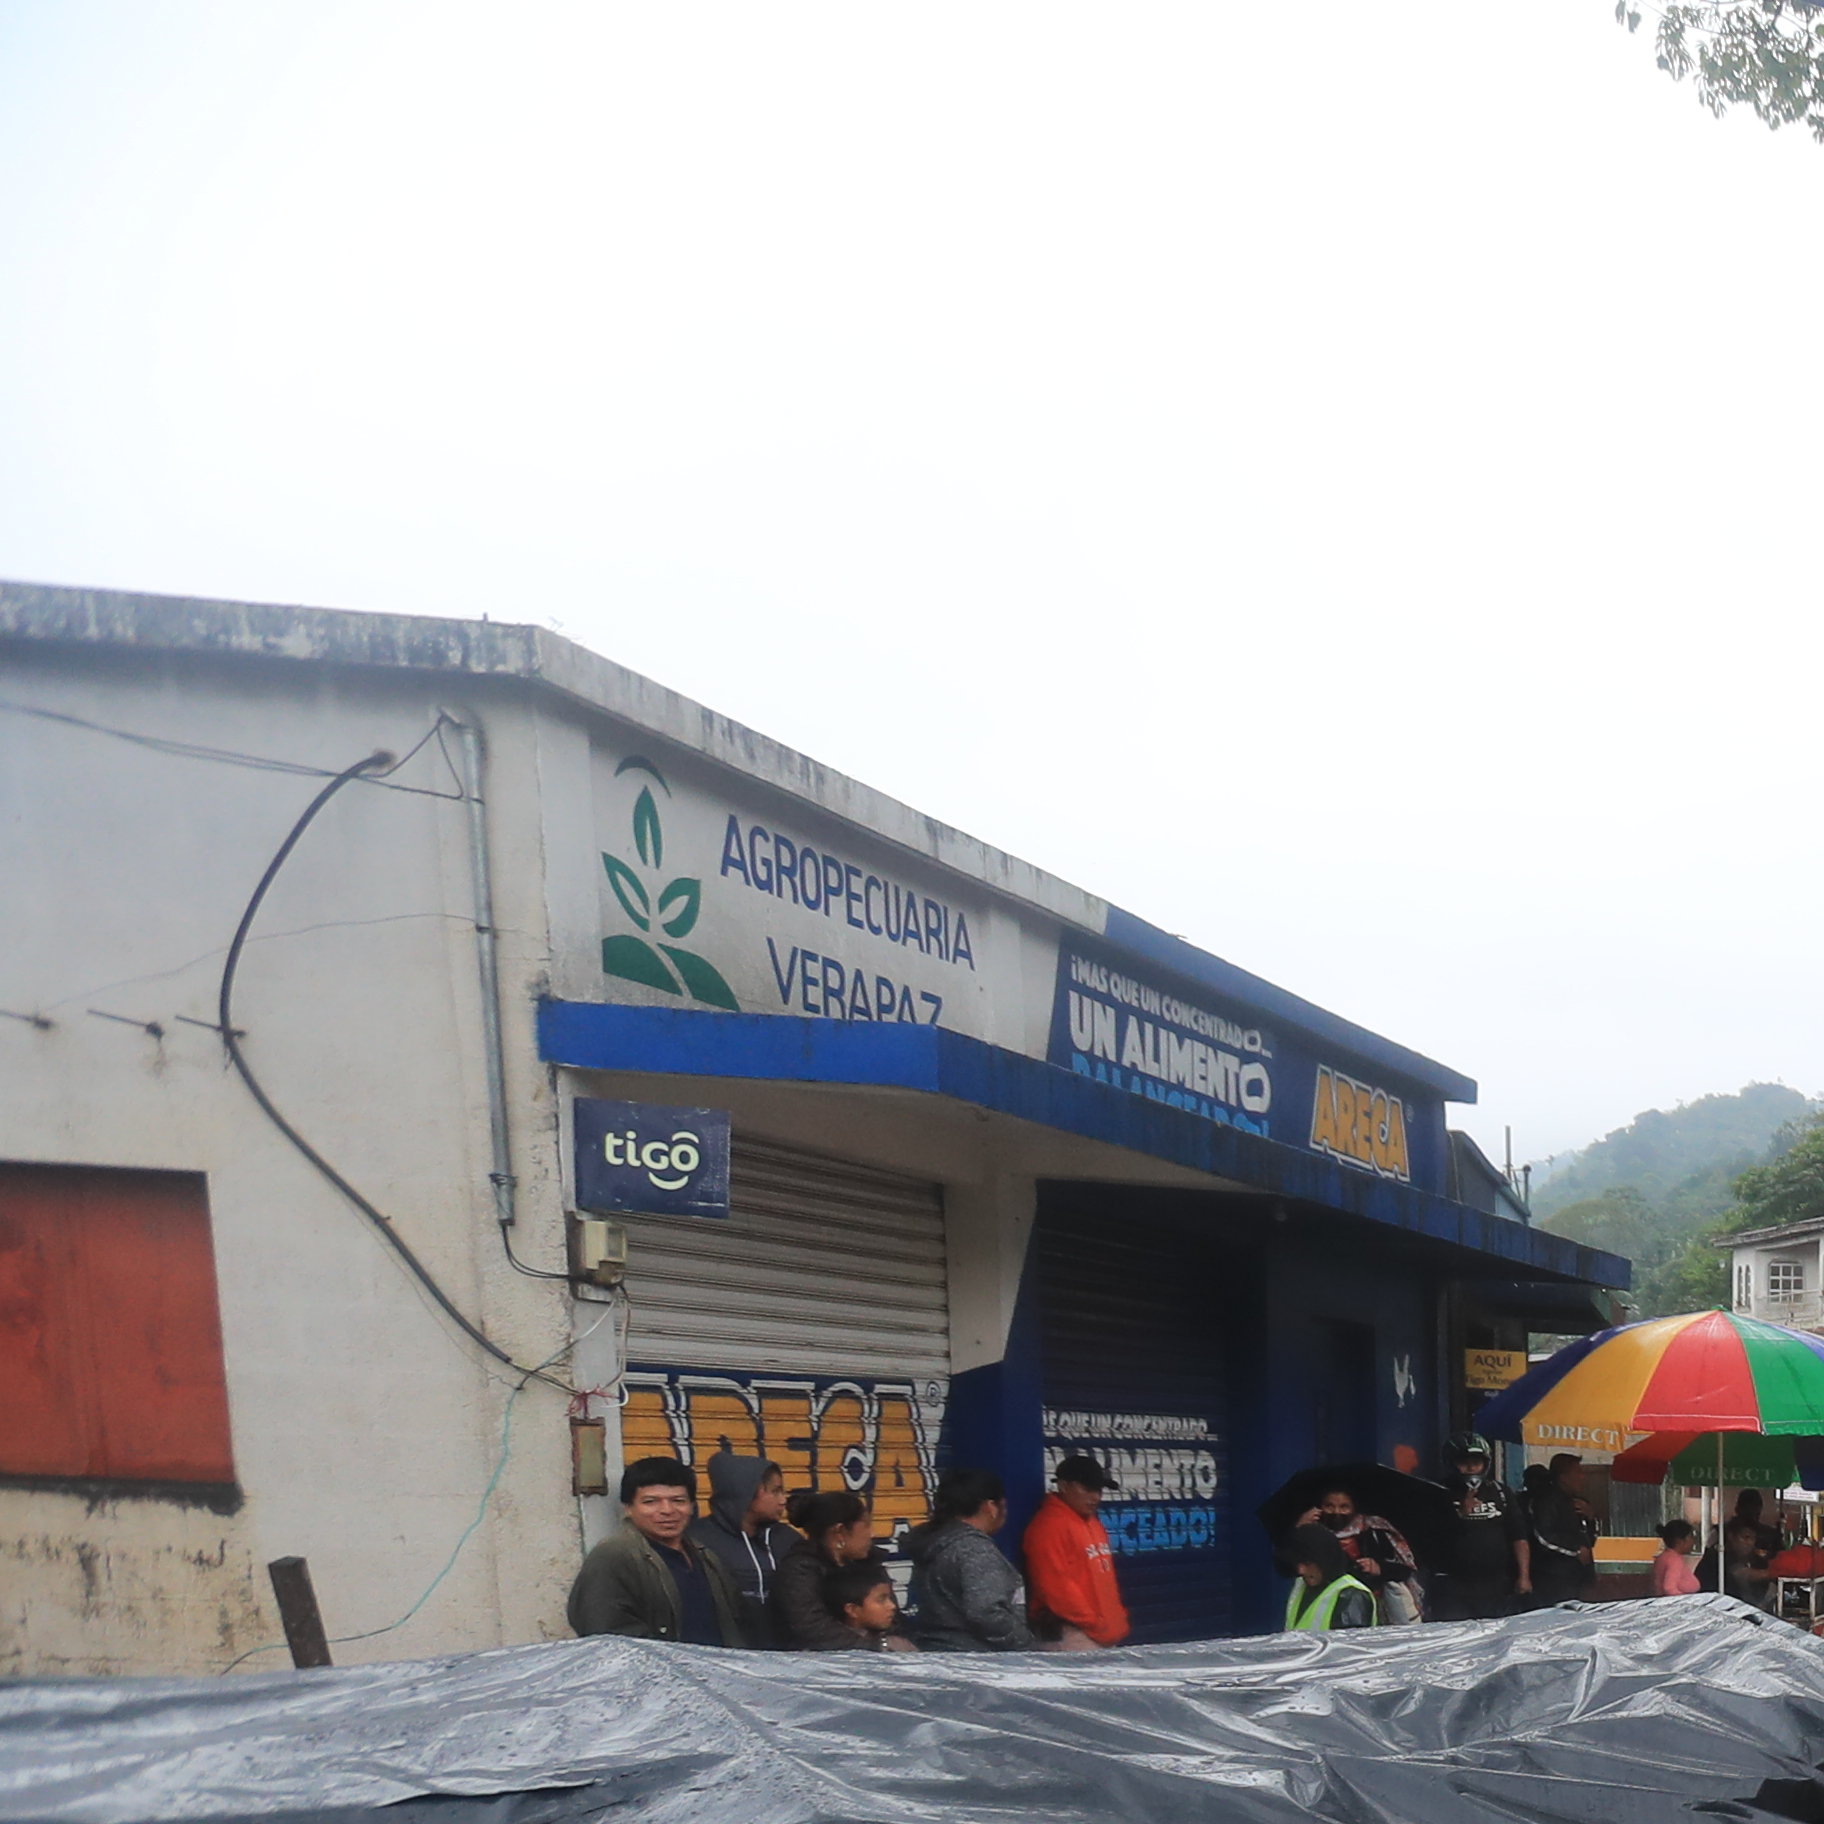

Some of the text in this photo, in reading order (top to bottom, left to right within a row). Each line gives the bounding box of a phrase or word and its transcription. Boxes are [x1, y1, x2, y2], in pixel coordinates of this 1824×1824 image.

[720, 814, 976, 972] AGROPECUARIA
[1110, 974, 1139, 1008] QUE
[1140, 985, 1161, 1016] UN
[1069, 990, 1272, 1114] UN ALIMENTO
[1538, 1423, 1619, 1445] DIRECT
